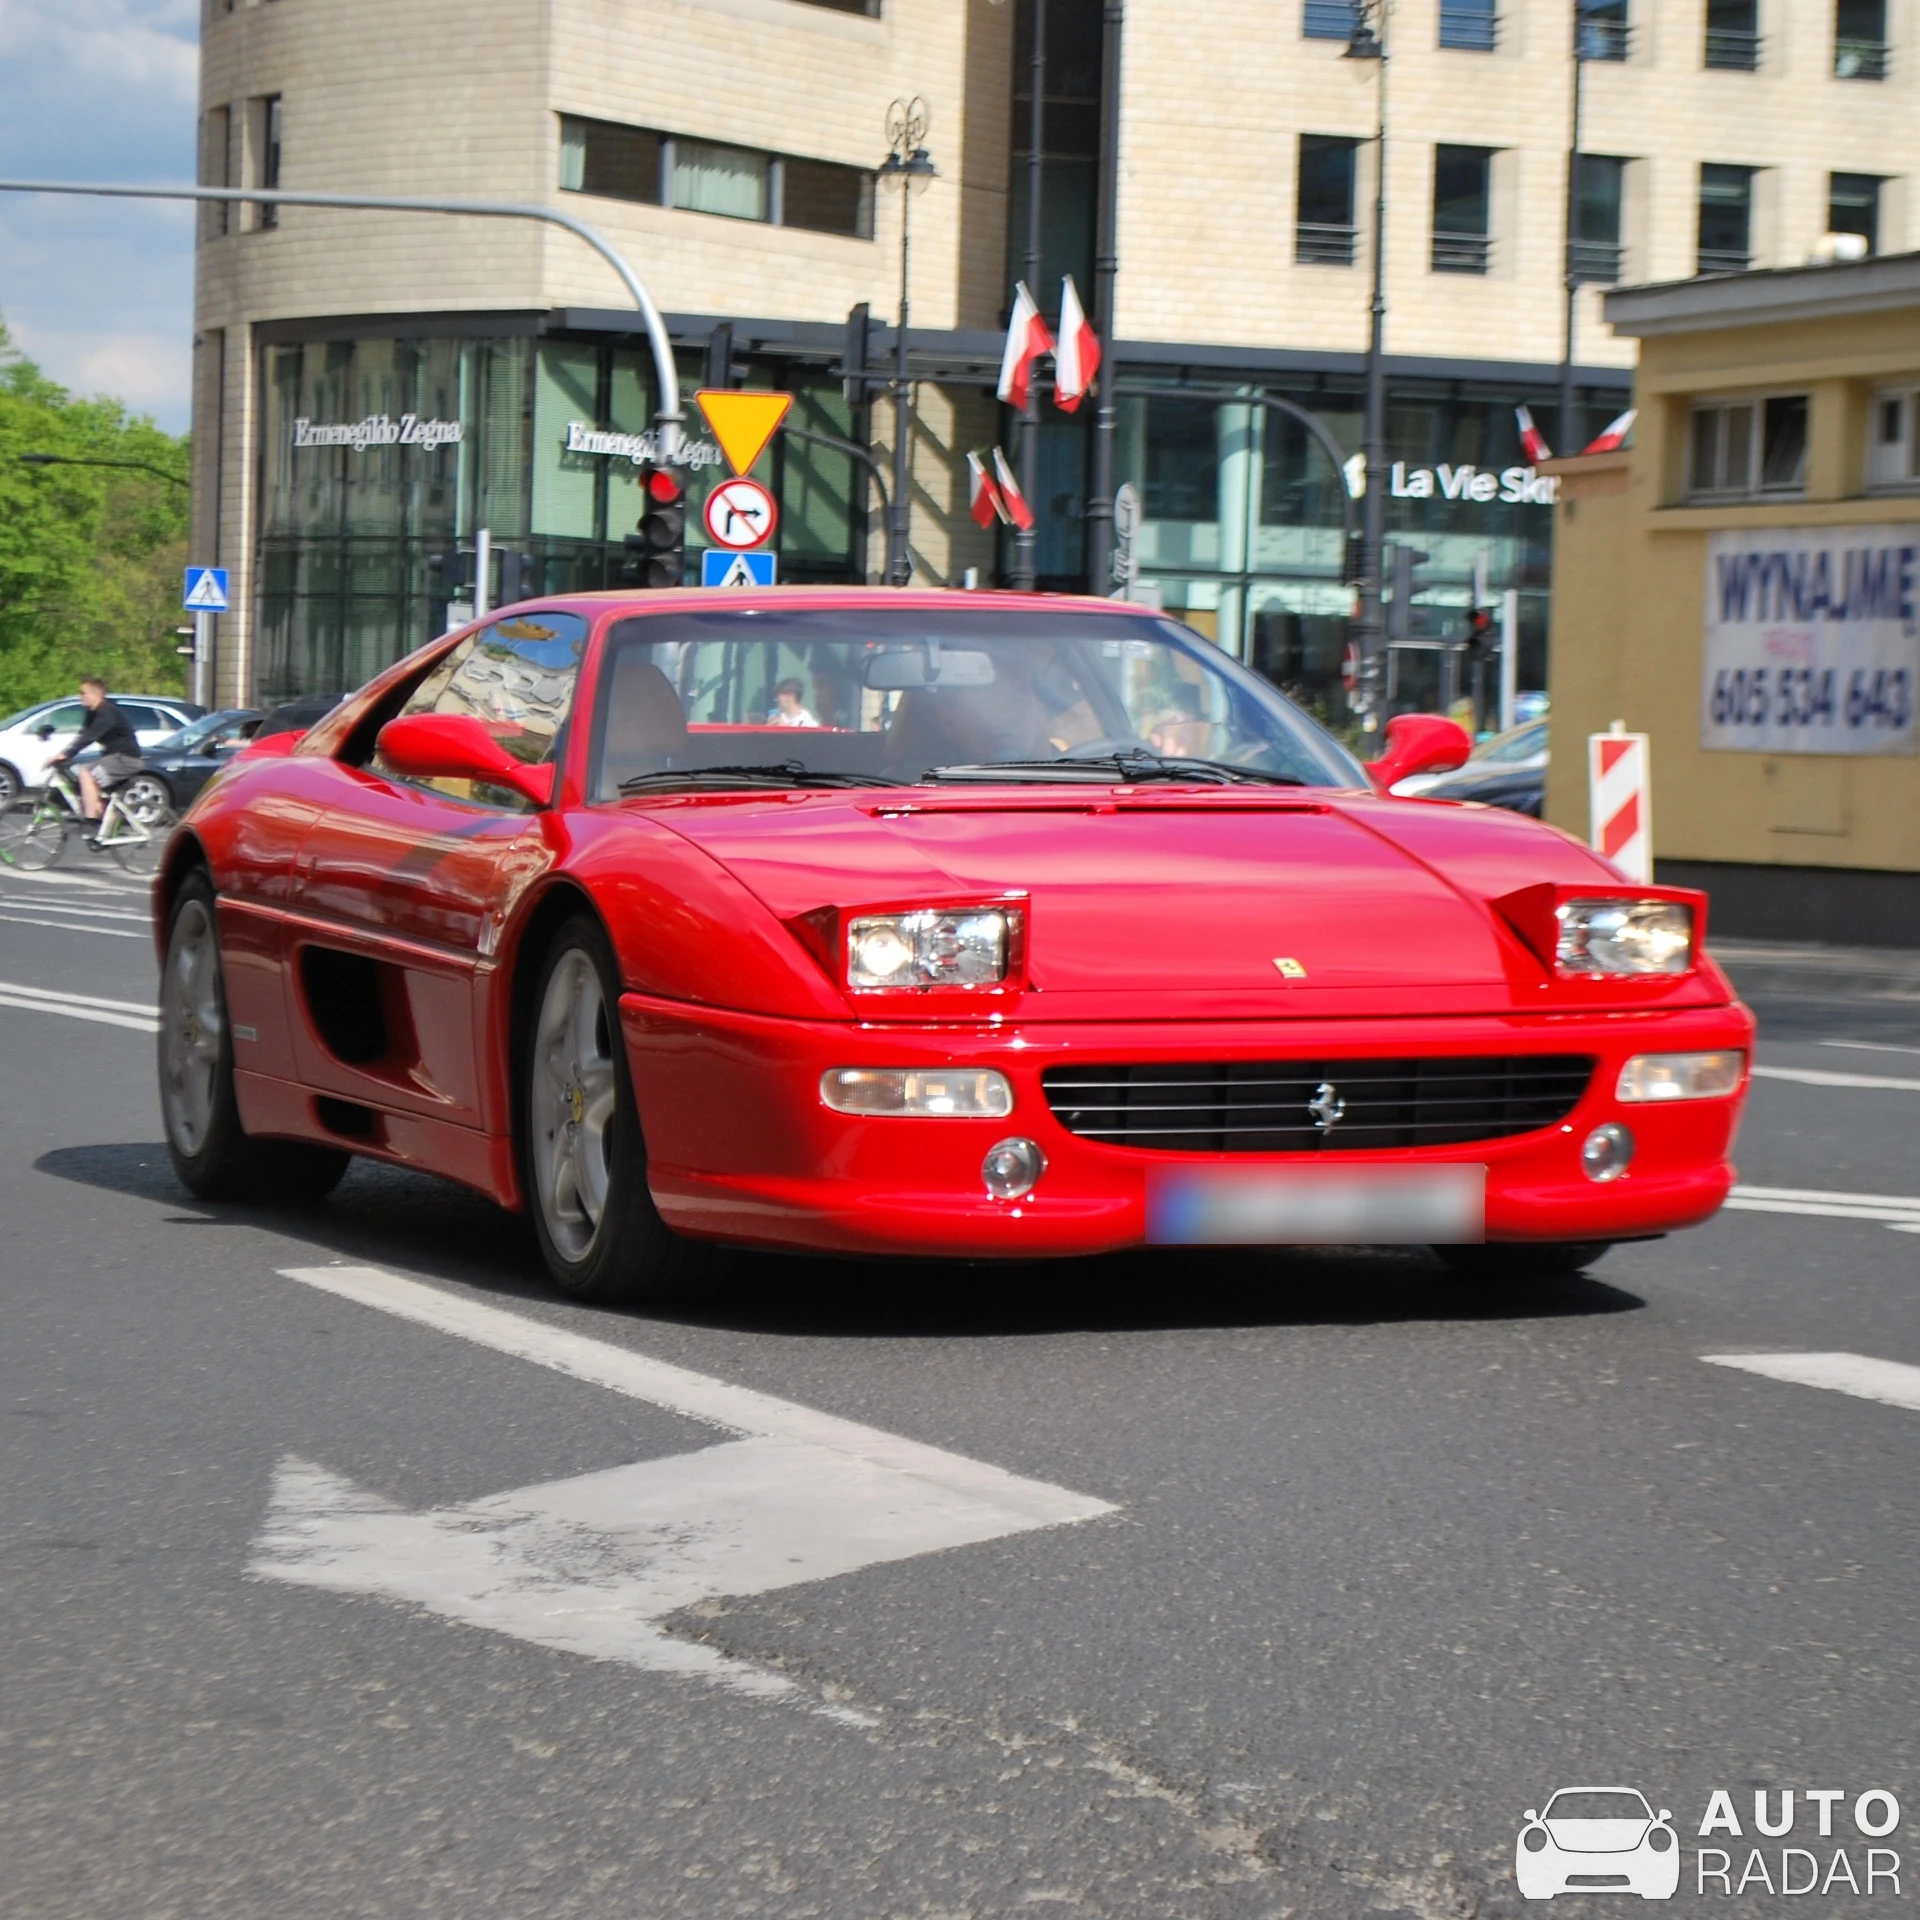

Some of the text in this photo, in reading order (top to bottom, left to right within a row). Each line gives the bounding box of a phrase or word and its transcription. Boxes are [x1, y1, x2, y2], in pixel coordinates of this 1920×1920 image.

[294, 413, 463, 451] Ermenegildo Zegna
[1392, 461, 1434, 498] La
[1436, 463, 1498, 502] Vie
